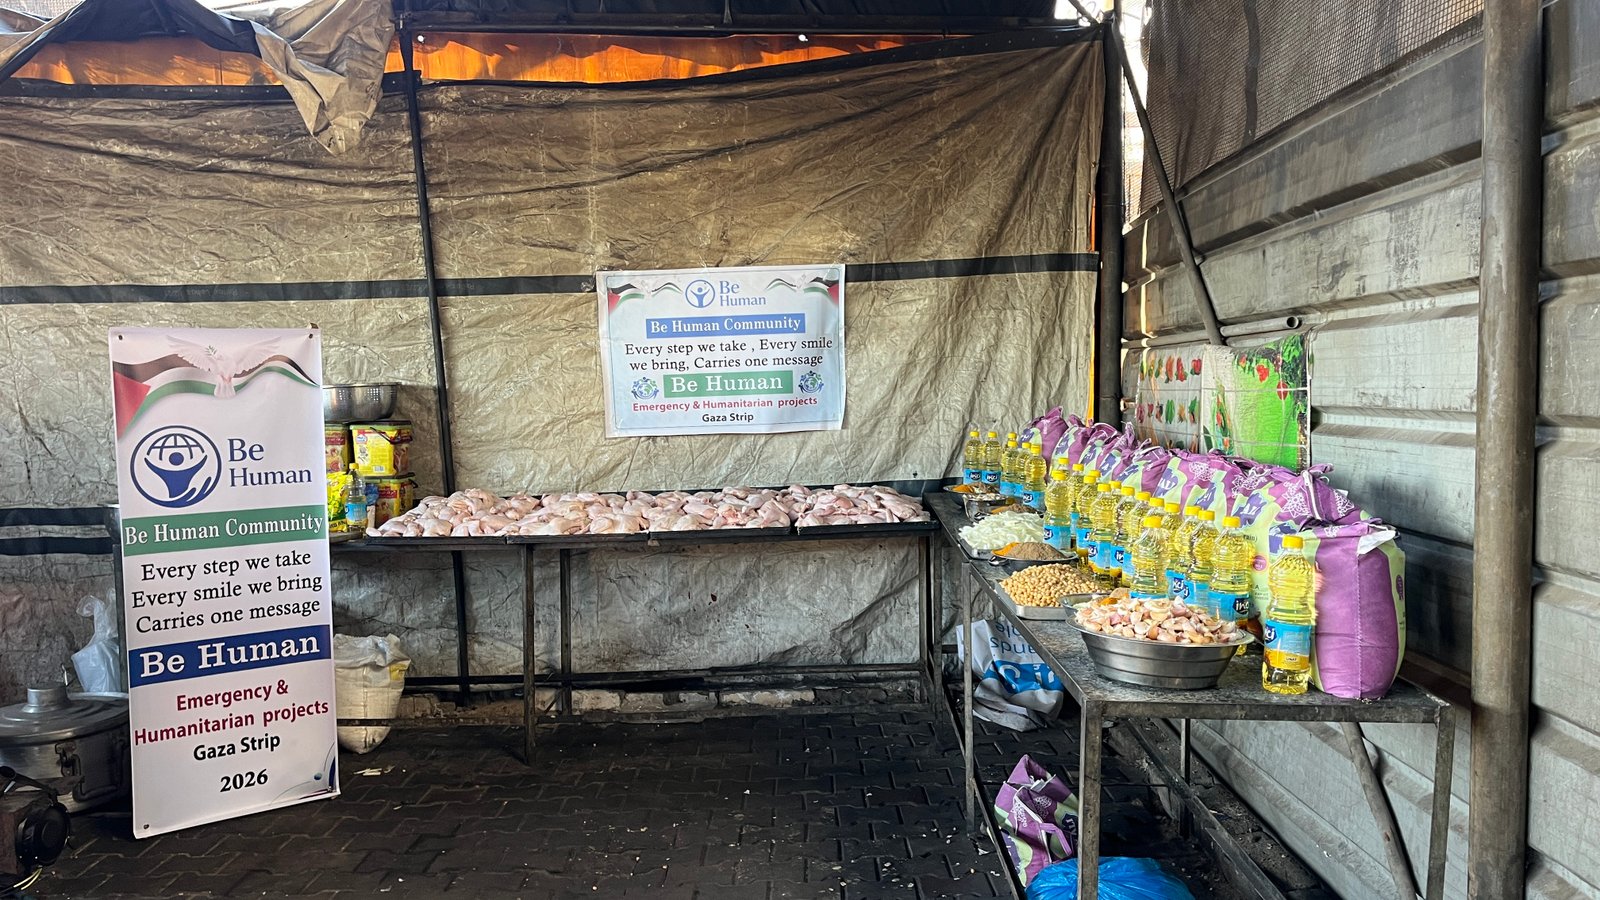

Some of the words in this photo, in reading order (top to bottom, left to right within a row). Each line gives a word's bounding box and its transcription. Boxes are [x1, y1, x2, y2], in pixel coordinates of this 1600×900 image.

[720, 280, 740, 294] Be
[720, 295, 766, 307] Human
[651, 321, 668, 333] Be
[673, 320, 720, 332] Human
[724, 317, 801, 333] Community
[625, 344, 664, 356] Every
[668, 342, 694, 356] step
[698, 342, 716, 353] we
[720, 340, 747, 352] take
[760, 339, 797, 352] Every
[801, 337, 833, 349] smile
[630, 360, 648, 371] we
[652, 359, 690, 372] bring,
[694, 356, 741, 369] Carries
[745, 358, 769, 367] one
[773, 355, 823, 367] message
[672, 377, 698, 393] Be
[706, 375, 783, 391] Human
[633, 402, 690, 413] Emergency
[693, 401, 701, 410] &
[703, 399, 773, 409] Humanitarian
[778, 397, 818, 409] projects
[702, 413, 728, 423] Gaza
[730, 413, 754, 423] Strip
[228, 439, 265, 462] Be
[230, 468, 312, 488] Human
[125, 526, 148, 546] Be
[154, 523, 220, 543] Human
[225, 514, 323, 537] Community
[141, 561, 197, 581] Every
[204, 558, 240, 577] step
[246, 555, 270, 570] we
[276, 551, 312, 567] take
[132, 588, 187, 609] Every
[194, 582, 242, 601] smile
[248, 580, 272, 595] we
[278, 576, 323, 593] bring
[136, 613, 204, 634] Carries
[211, 610, 243, 625] one
[250, 600, 321, 620] message
[140, 652, 185, 678] Be
[198, 636, 320, 669] Human
[177, 685, 272, 711] Emergency
[277, 680, 289, 695] &
[135, 712, 255, 746] Humanitarian
[263, 701, 329, 727] projects
[194, 741, 236, 761] Gaza
[241, 733, 281, 753] Strip
[220, 769, 268, 793] 2026
